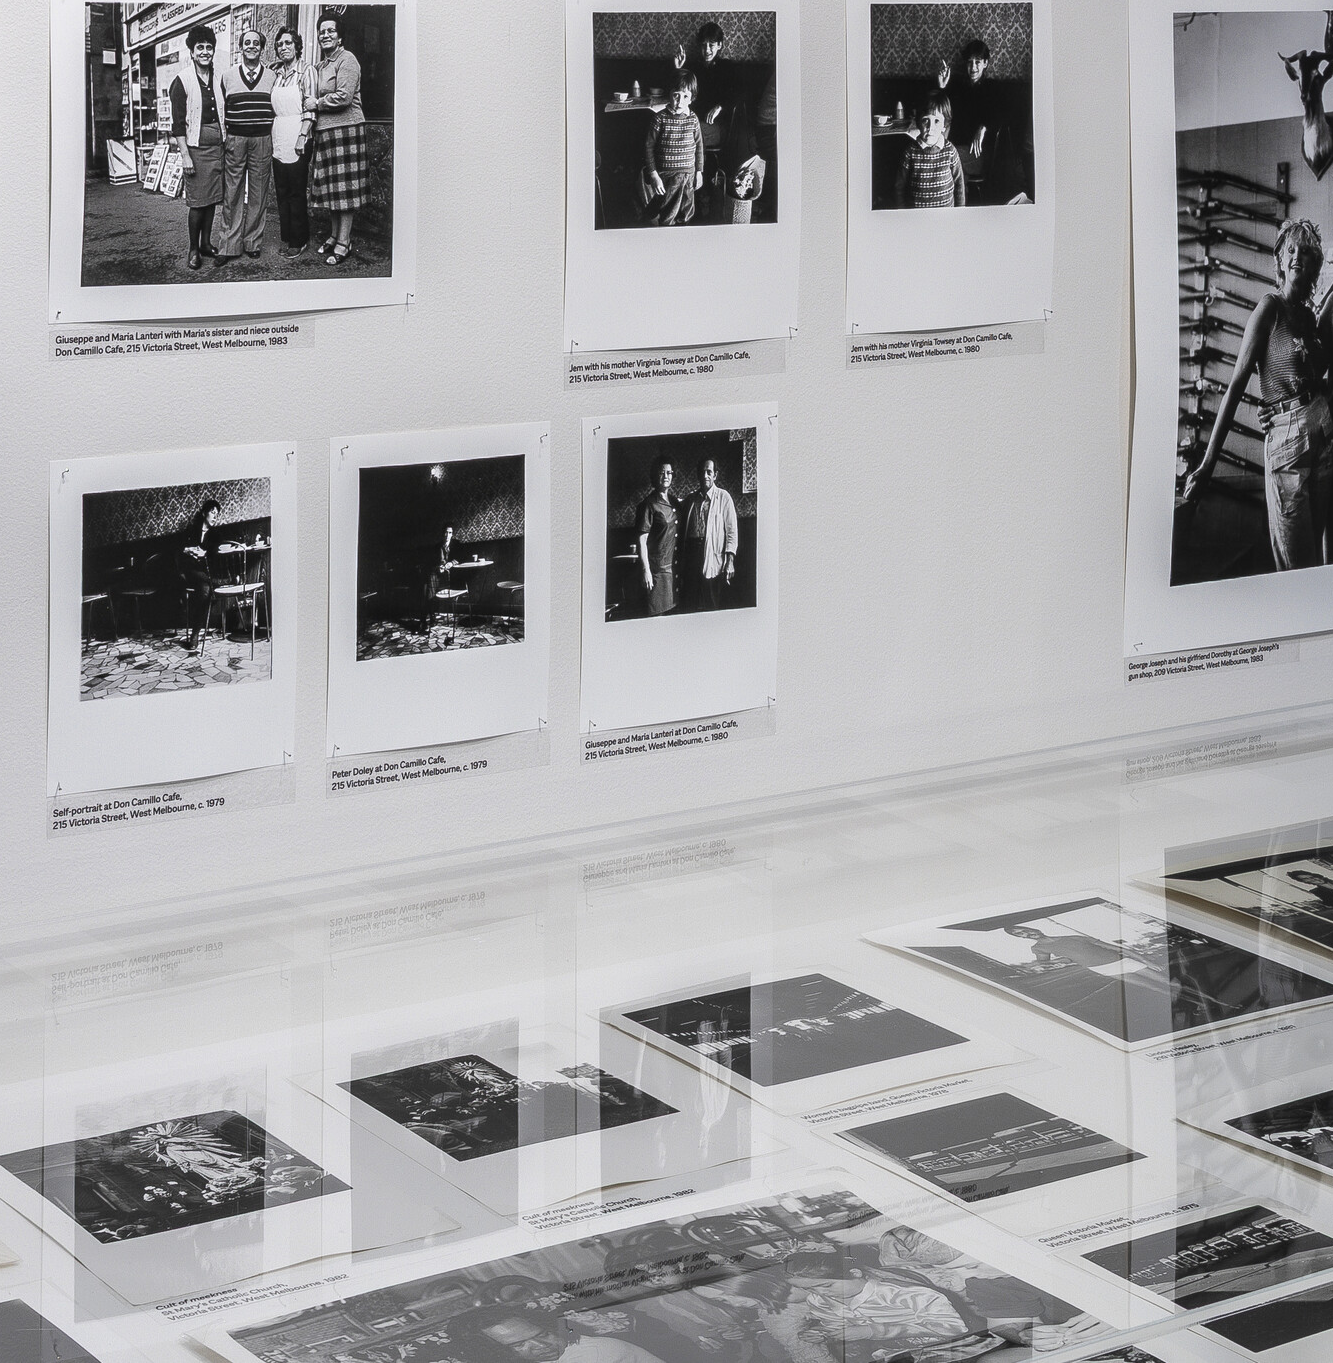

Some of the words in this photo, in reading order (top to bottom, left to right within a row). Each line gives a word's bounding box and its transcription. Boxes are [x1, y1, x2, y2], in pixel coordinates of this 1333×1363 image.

[331, 769, 352, 779] Peter
[352, 766, 374, 777] Doley
[374, 764, 383, 773] at
[383, 762, 399, 772] Don
[399, 758, 427, 769] Camillo
[331, 780, 345, 791] 215
[346, 777, 375, 789] Victoria
[400, 770, 421, 780] West
[462, 764, 469, 772] c.
[470, 759, 488, 770] 1979
[156, 1303, 175, 1311] Cult
[190, 1288, 237, 1302] meekness
[167, 1310, 207, 1321] Victoria
[209, 1301, 242, 1313] Street,
[243, 1294, 268, 1303] West
[267, 1282, 324, 1297] Melbourne,
[325, 1273, 349, 1283] 1982
[209, 1291, 249, 1305] Catholic
[250, 1283, 288, 1295] Church,
